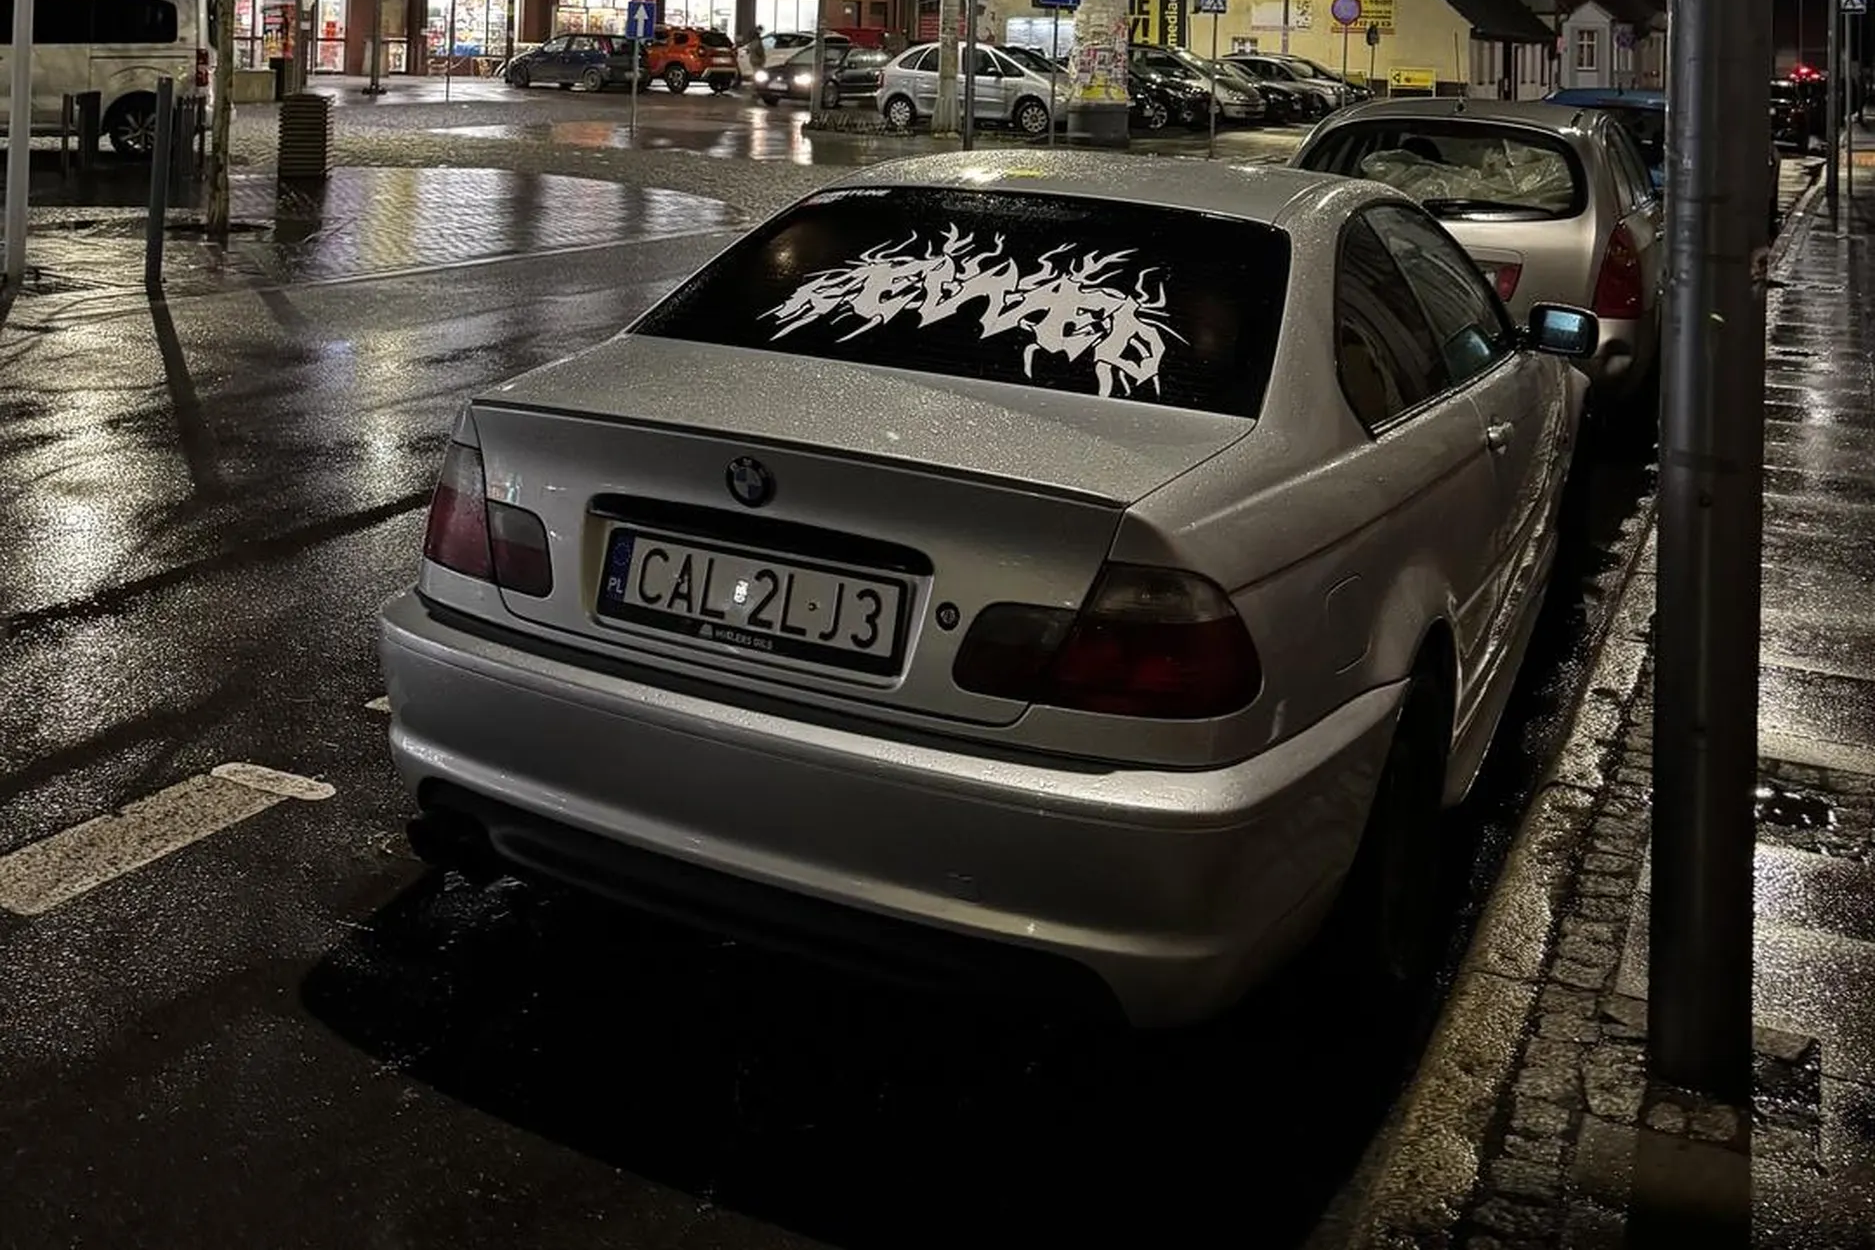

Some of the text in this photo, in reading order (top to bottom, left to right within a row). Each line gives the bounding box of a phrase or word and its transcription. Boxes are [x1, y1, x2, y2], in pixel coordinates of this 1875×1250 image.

[607, 576, 624, 594] PL
[637, 548, 884, 649] CAL 2LJ3
